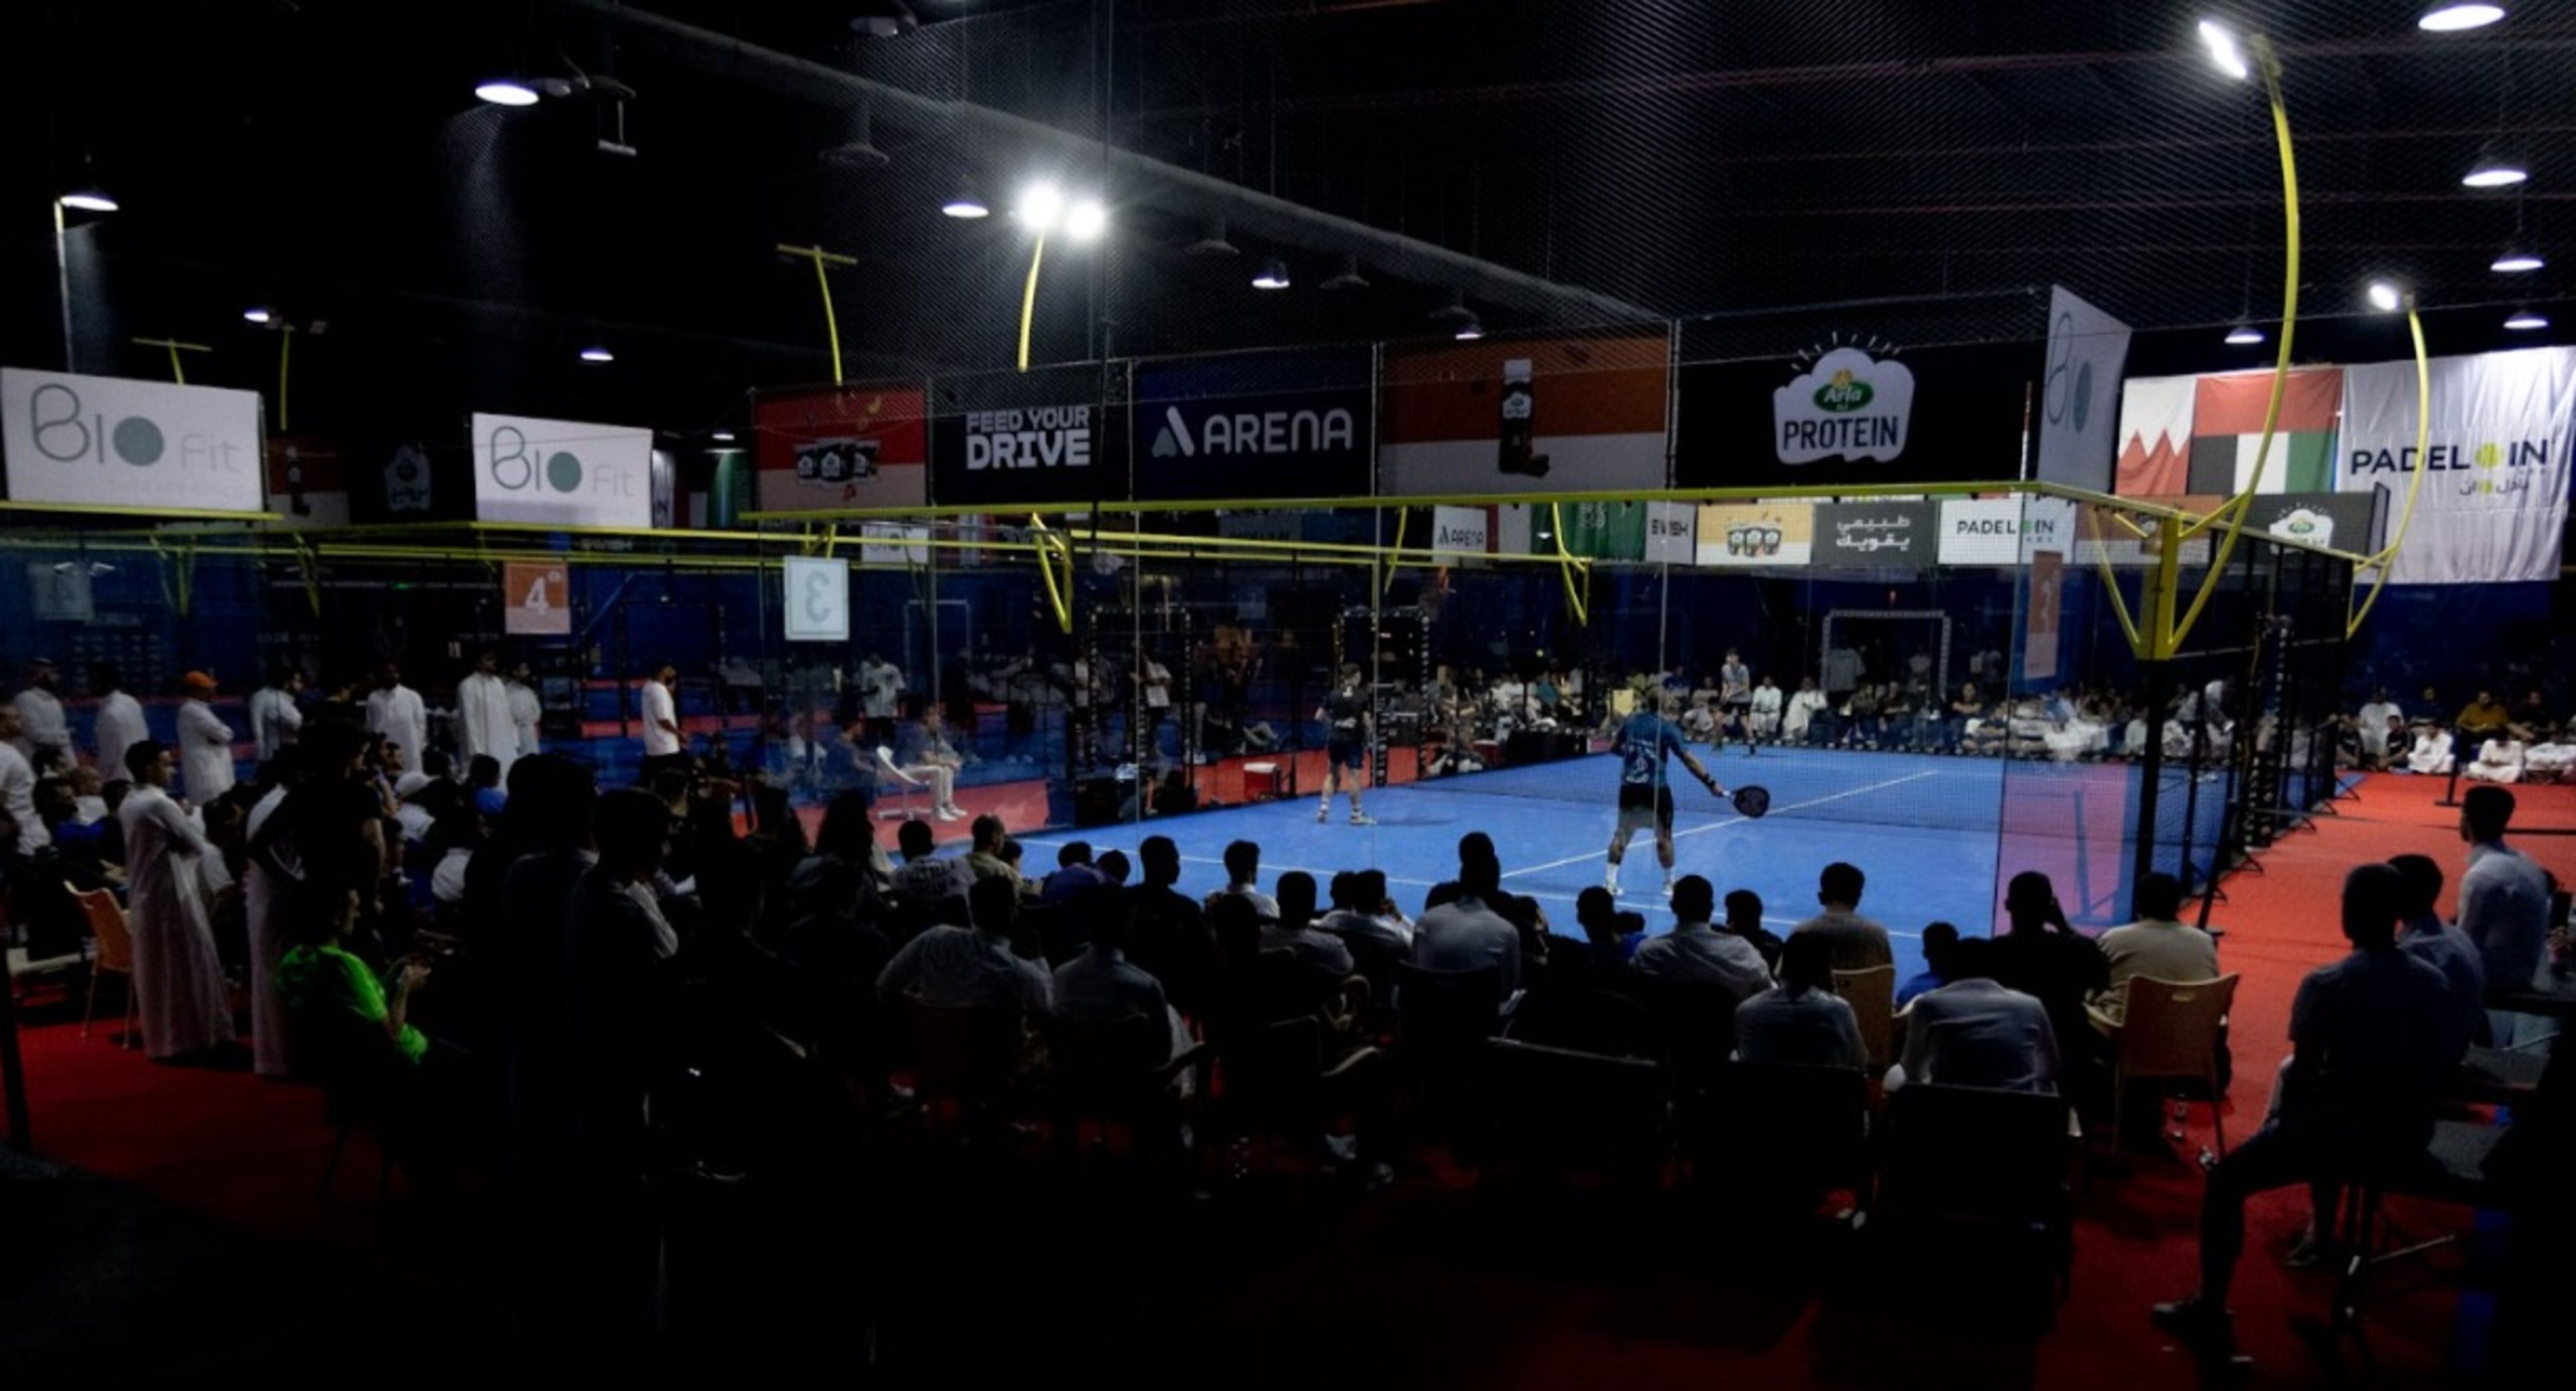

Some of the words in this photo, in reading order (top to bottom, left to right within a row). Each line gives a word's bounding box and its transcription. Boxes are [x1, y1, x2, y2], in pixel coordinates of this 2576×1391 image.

[966, 410, 1023, 433] FEED
[1027, 406, 1091, 431] YOUR
[1203, 407, 1354, 456] ARENA
[1783, 416, 1898, 450] PROTEIN
[966, 429, 1091, 471] DRIVE
[1956, 518, 2017, 535] PADEL
